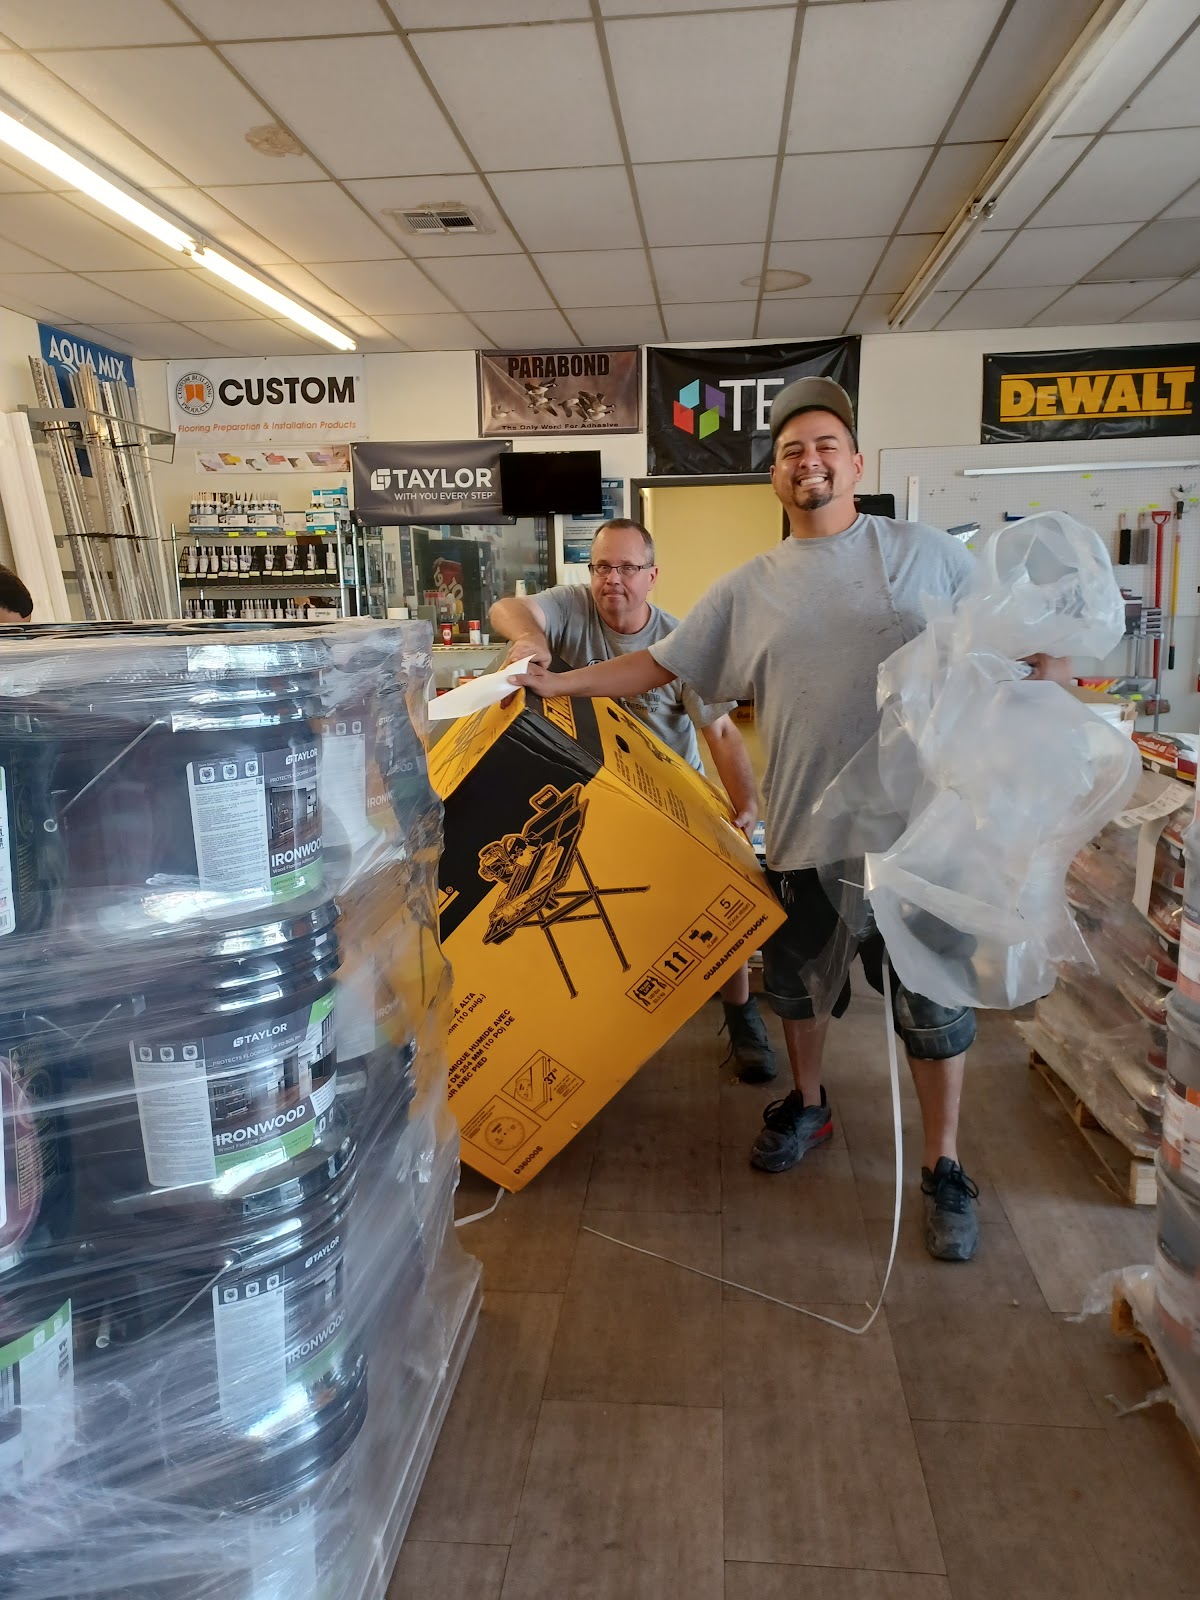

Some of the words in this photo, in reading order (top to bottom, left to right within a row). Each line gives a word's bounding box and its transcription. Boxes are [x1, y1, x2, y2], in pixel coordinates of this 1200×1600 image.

[49, 335, 97, 373] AQUA
[98, 352, 127, 383] MIX
[508, 354, 610, 378] PARABOND
[218, 376, 355, 406] CUSTOM
[178, 424, 210, 433] Flooring
[213, 423, 260, 432] Preparation
[271, 421, 318, 430] Installation
[319, 420, 357, 429] Products
[392, 468, 492, 489] TAYLOR
[394, 492, 417, 500] WITH
[419, 492, 438, 500] YOU
[440, 491, 469, 500] EVERY
[470, 491, 493, 499] STEP
[293, 748, 318, 764] TAYLOR
[719, 898, 731, 910] 5
[703, 938, 745, 981] GUARANTEED
[459, 992, 476, 1009] ALTA
[456, 1011, 469, 1024] (10
[244, 1023, 288, 1043] TAYLOR
[448, 1051, 471, 1077] AMIQUE
[468, 1025, 494, 1052] HUMIDE
[493, 1008, 511, 1027] AVEC
[212, 1055, 242, 1067] PROTECTS
[243, 1046, 270, 1060] FLOORING
[450, 1073, 461, 1084] DE
[459, 1061, 473, 1074] 254
[471, 1048, 484, 1062] MM
[482, 1038, 495, 1050] (10
[493, 1026, 507, 1039] PO)
[504, 1015, 516, 1027] DE
[456, 1071, 474, 1090] AVEC
[472, 1056, 488, 1073] PIED
[543, 1068, 558, 1085] 37"
[215, 1104, 306, 1147] IRONWOOD
[217, 1142, 235, 1153] Wood
[513, 1145, 543, 1175] D36000S
[311, 1235, 340, 1263] TAYLOR
[287, 1308, 346, 1364] IRONWOOD
